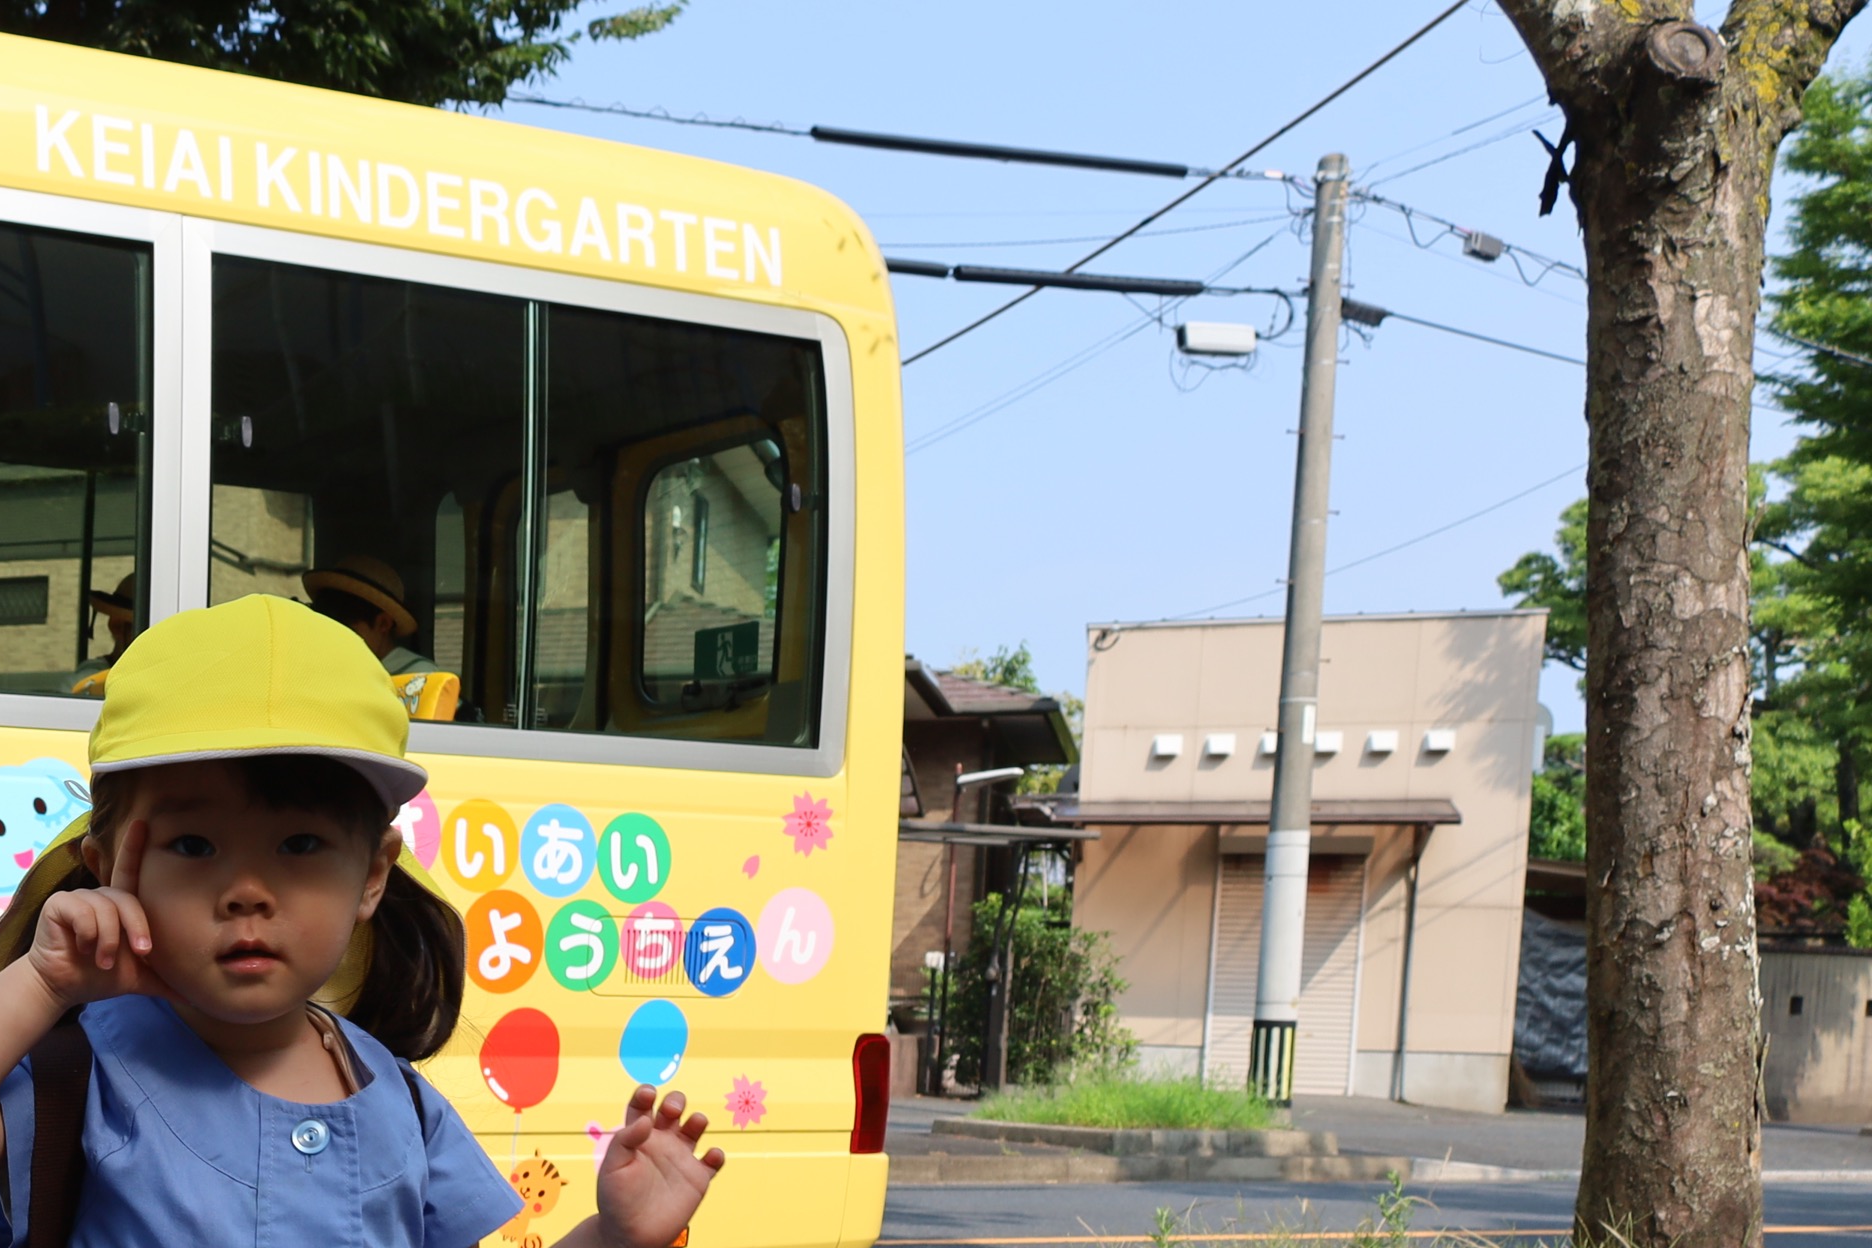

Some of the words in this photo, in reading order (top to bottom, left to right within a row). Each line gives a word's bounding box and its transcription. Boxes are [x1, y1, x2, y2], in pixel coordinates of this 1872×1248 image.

[34, 104, 233, 203] KEIAI
[255, 141, 783, 287] KINDERGARTEN
[477, 905, 816, 982] ようちえん
